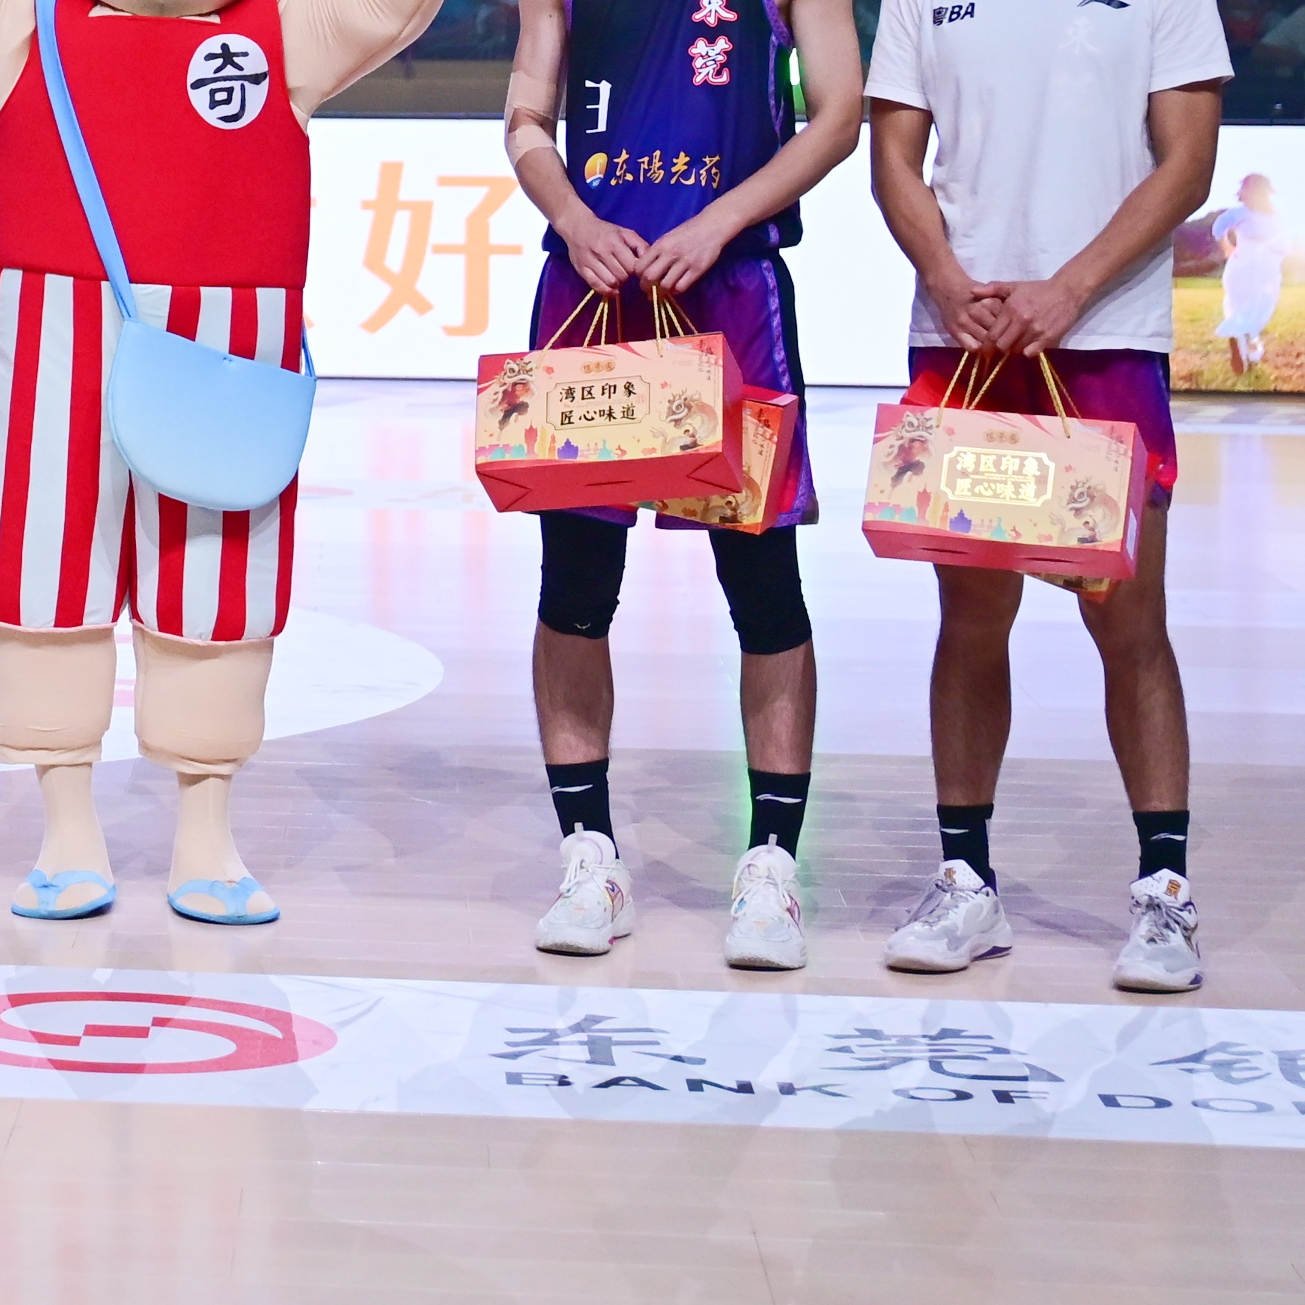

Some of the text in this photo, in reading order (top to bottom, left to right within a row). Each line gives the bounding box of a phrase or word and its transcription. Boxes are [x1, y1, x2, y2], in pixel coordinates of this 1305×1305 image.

[932, 2, 975, 26] 粤BA
[190, 43, 268, 123] 奇
[559, 381, 637, 403] 湾区印象
[559, 403, 637, 426] 匠心味道
[956, 452, 1041, 476] 湾区印象
[954, 479, 1038, 504] 匠心味道
[504, 1071, 1305, 1115] BANK OF DO
